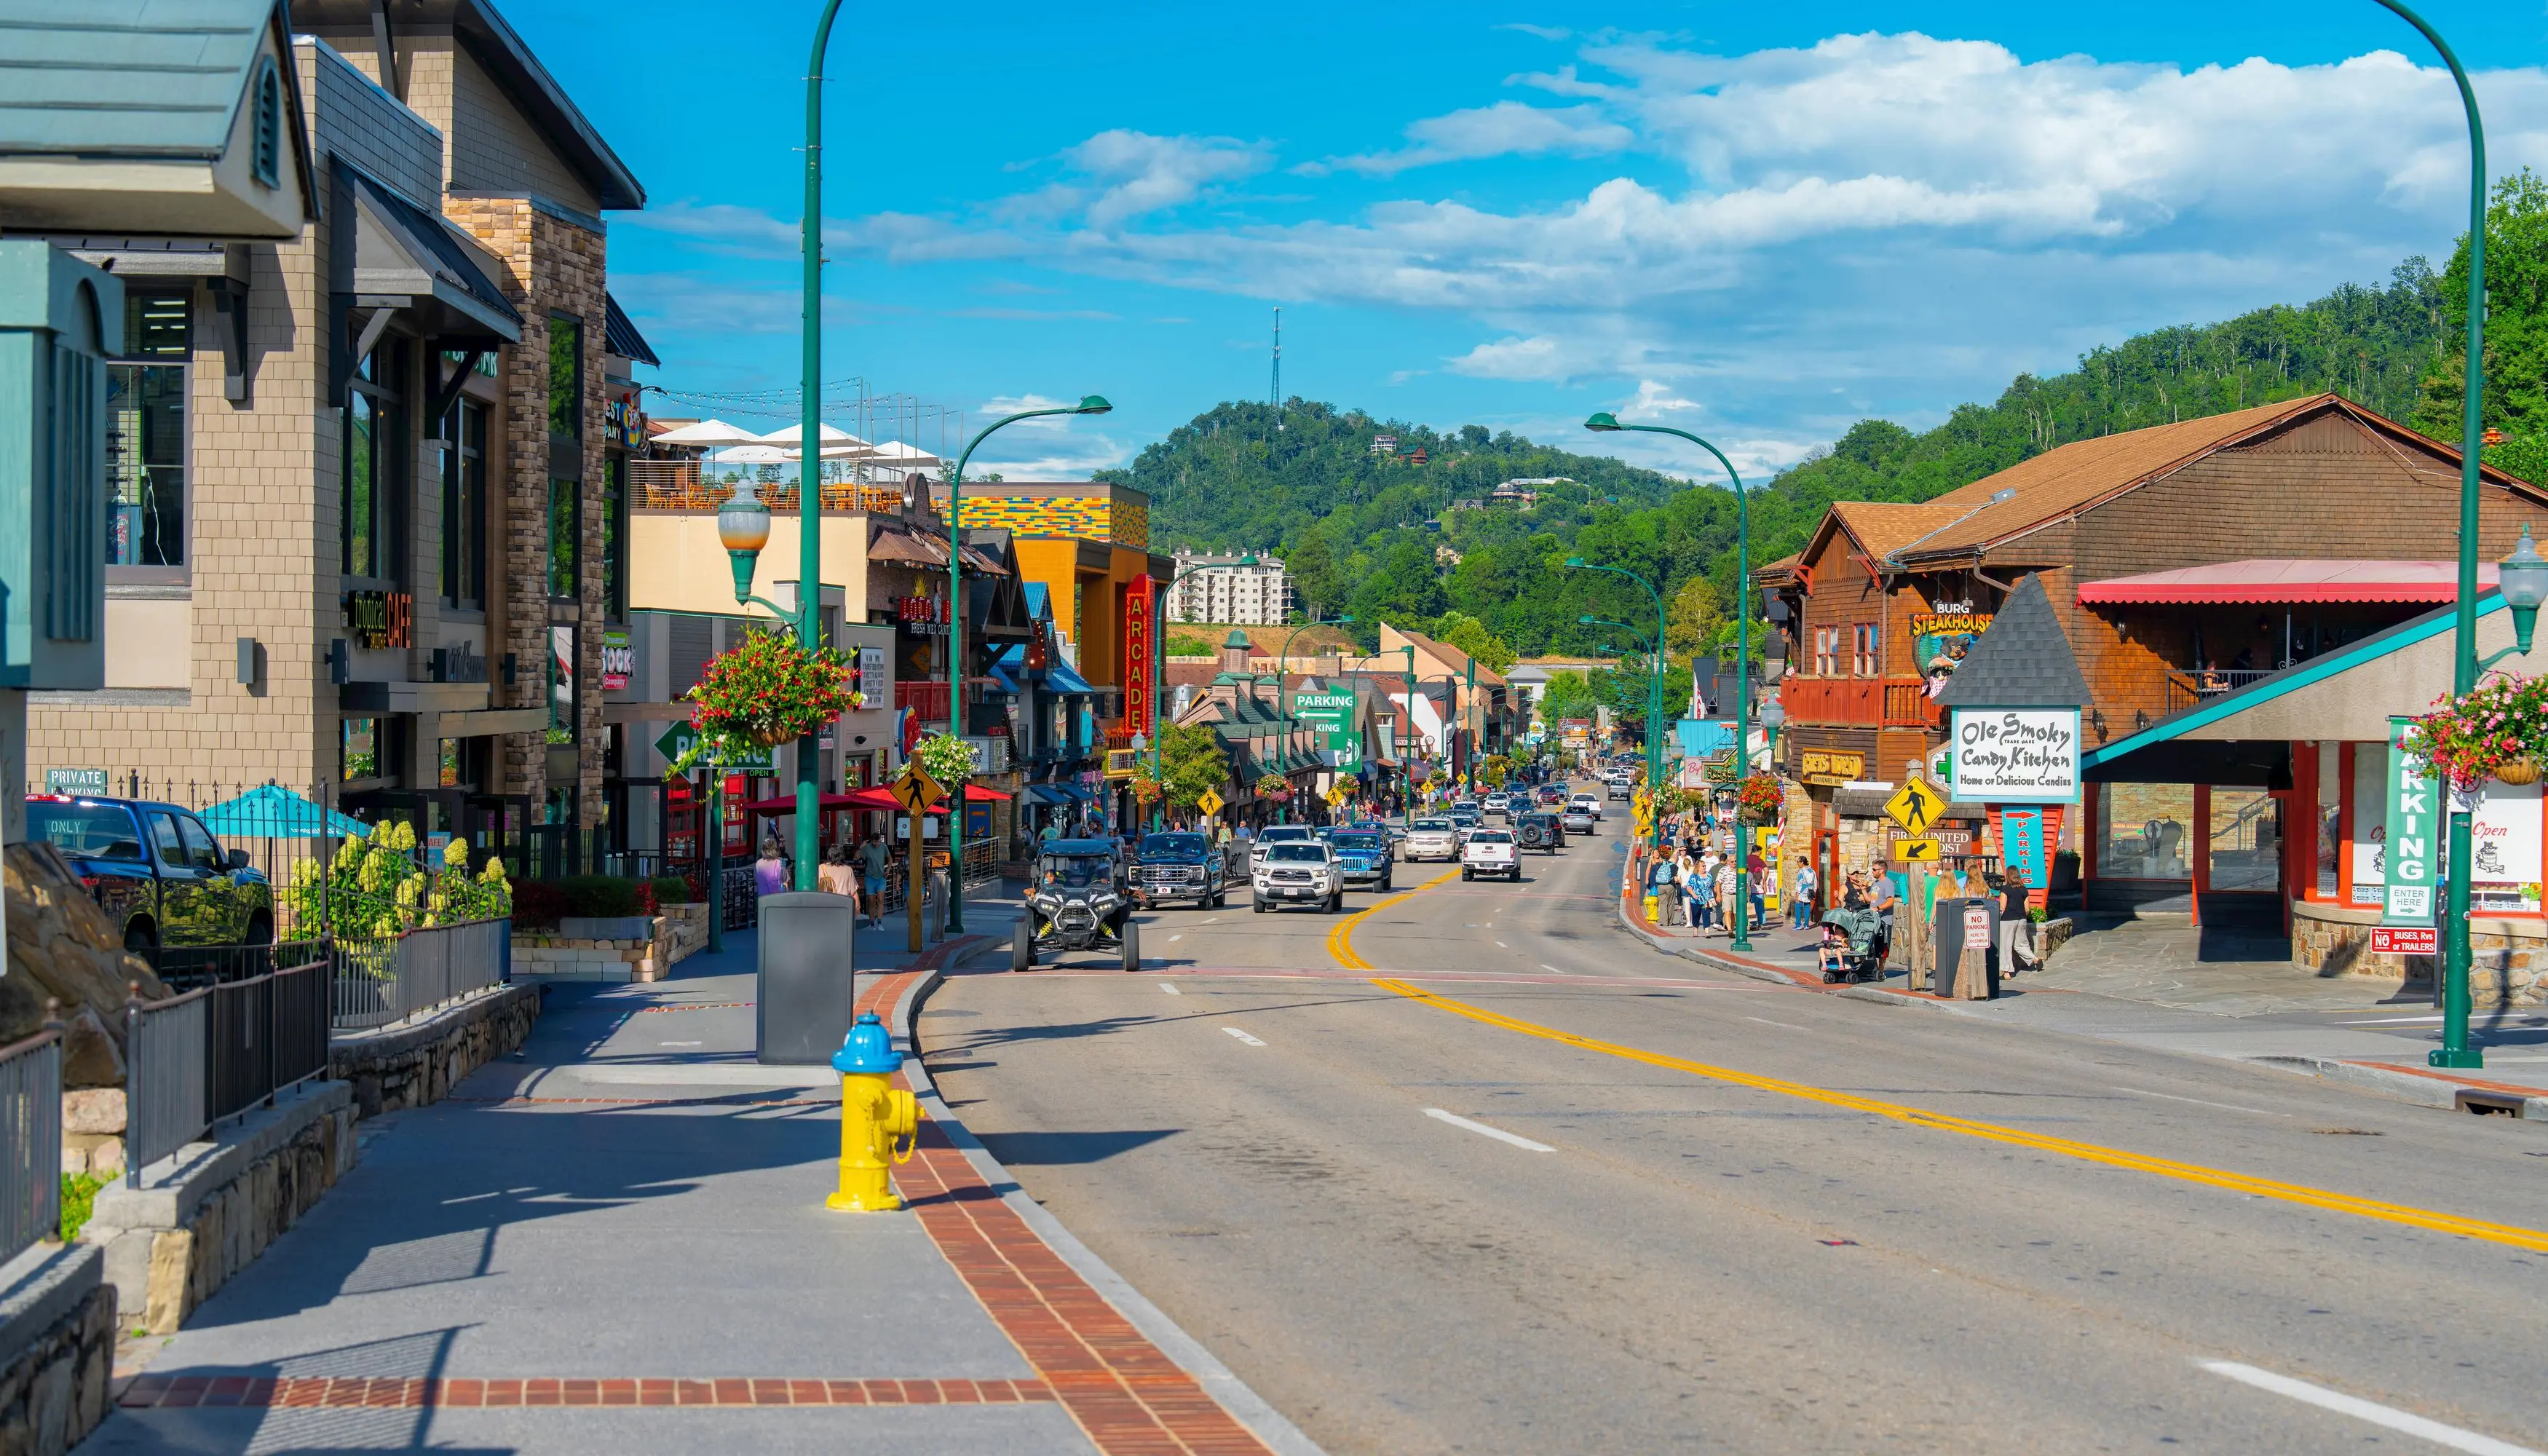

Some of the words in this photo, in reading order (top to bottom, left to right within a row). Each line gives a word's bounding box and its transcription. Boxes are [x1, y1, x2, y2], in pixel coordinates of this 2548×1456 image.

[1937, 604, 1969, 613] BURG
[355, 591, 387, 636] tropical
[387, 592, 413, 649] CAFE
[1913, 614, 1993, 636] STEAKHOUSE
[911, 623, 925, 634] FRESH
[927, 624, 937, 635] MEX
[605, 636, 625, 644] Tennessee
[1131, 598, 1142, 727] ARCADE
[605, 677, 625, 687] Company
[1297, 696, 1353, 706] PARKING
[1962, 721, 1998, 745] Ole
[1999, 713, 2070, 752] Smoky
[1962, 749, 2007, 775] Candy
[2007, 745, 2070, 776] Kitchen
[51, 770, 101, 784] PRIVATE
[1813, 775, 1832, 784] SOUVENIRS
[1961, 775, 1982, 785] Home
[1996, 775, 2035, 786] Delicious
[2038, 775, 2072, 786] Candies
[51, 787, 101, 796] PRKING
[51, 820, 80, 834] ONLY
[2472, 820, 2508, 839] Open
[1926, 832, 1969, 843] UNITED
[2017, 820, 2033, 885] PARKING
[2394, 890, 2424, 898] ENTER
[2397, 898, 2421, 906] HERE
[2375, 935, 2390, 946] NO
[2394, 932, 2420, 941] BUSES,
[2421, 932, 2434, 941] Rvs
[2402, 943, 2434, 951] TRAILERS
